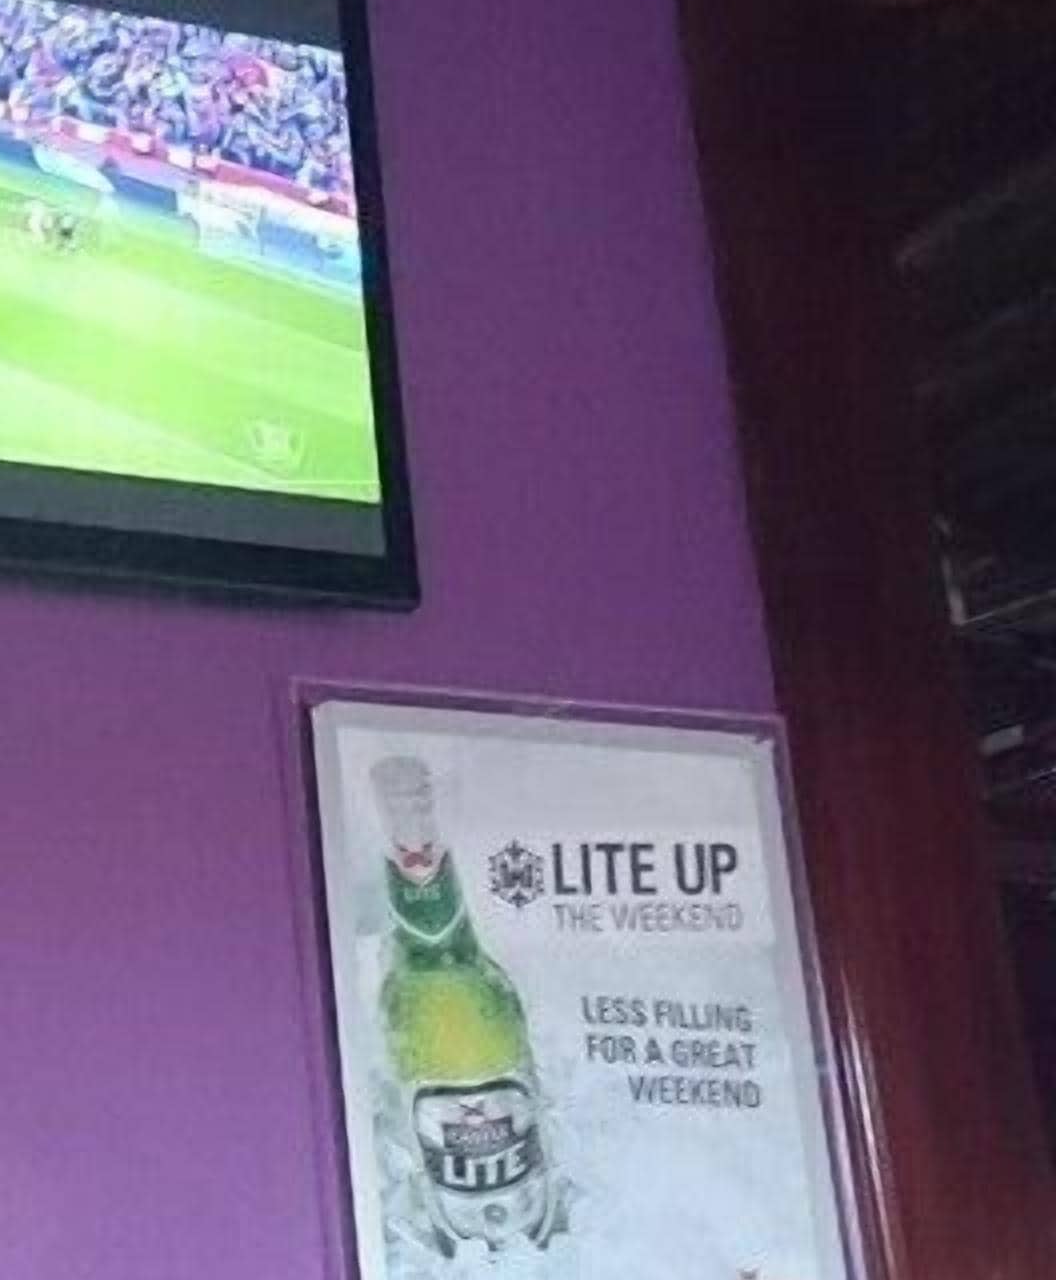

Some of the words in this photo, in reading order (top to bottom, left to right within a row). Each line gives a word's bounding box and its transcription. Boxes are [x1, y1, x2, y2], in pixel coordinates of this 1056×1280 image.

[551, 842, 658, 897] LITE
[673, 842, 739, 897] UP
[550, 902, 604, 933] THE
[607, 902, 743, 933] WEEKEND
[580, 995, 648, 1027] LESS
[652, 999, 753, 1033] FILLING
[585, 1034, 638, 1064] FOR
[644, 1036, 665, 1065] A
[671, 1039, 757, 1069] GREAT
[627, 1074, 761, 1109] WEEKEND
[443, 1140, 527, 1188] LITE
